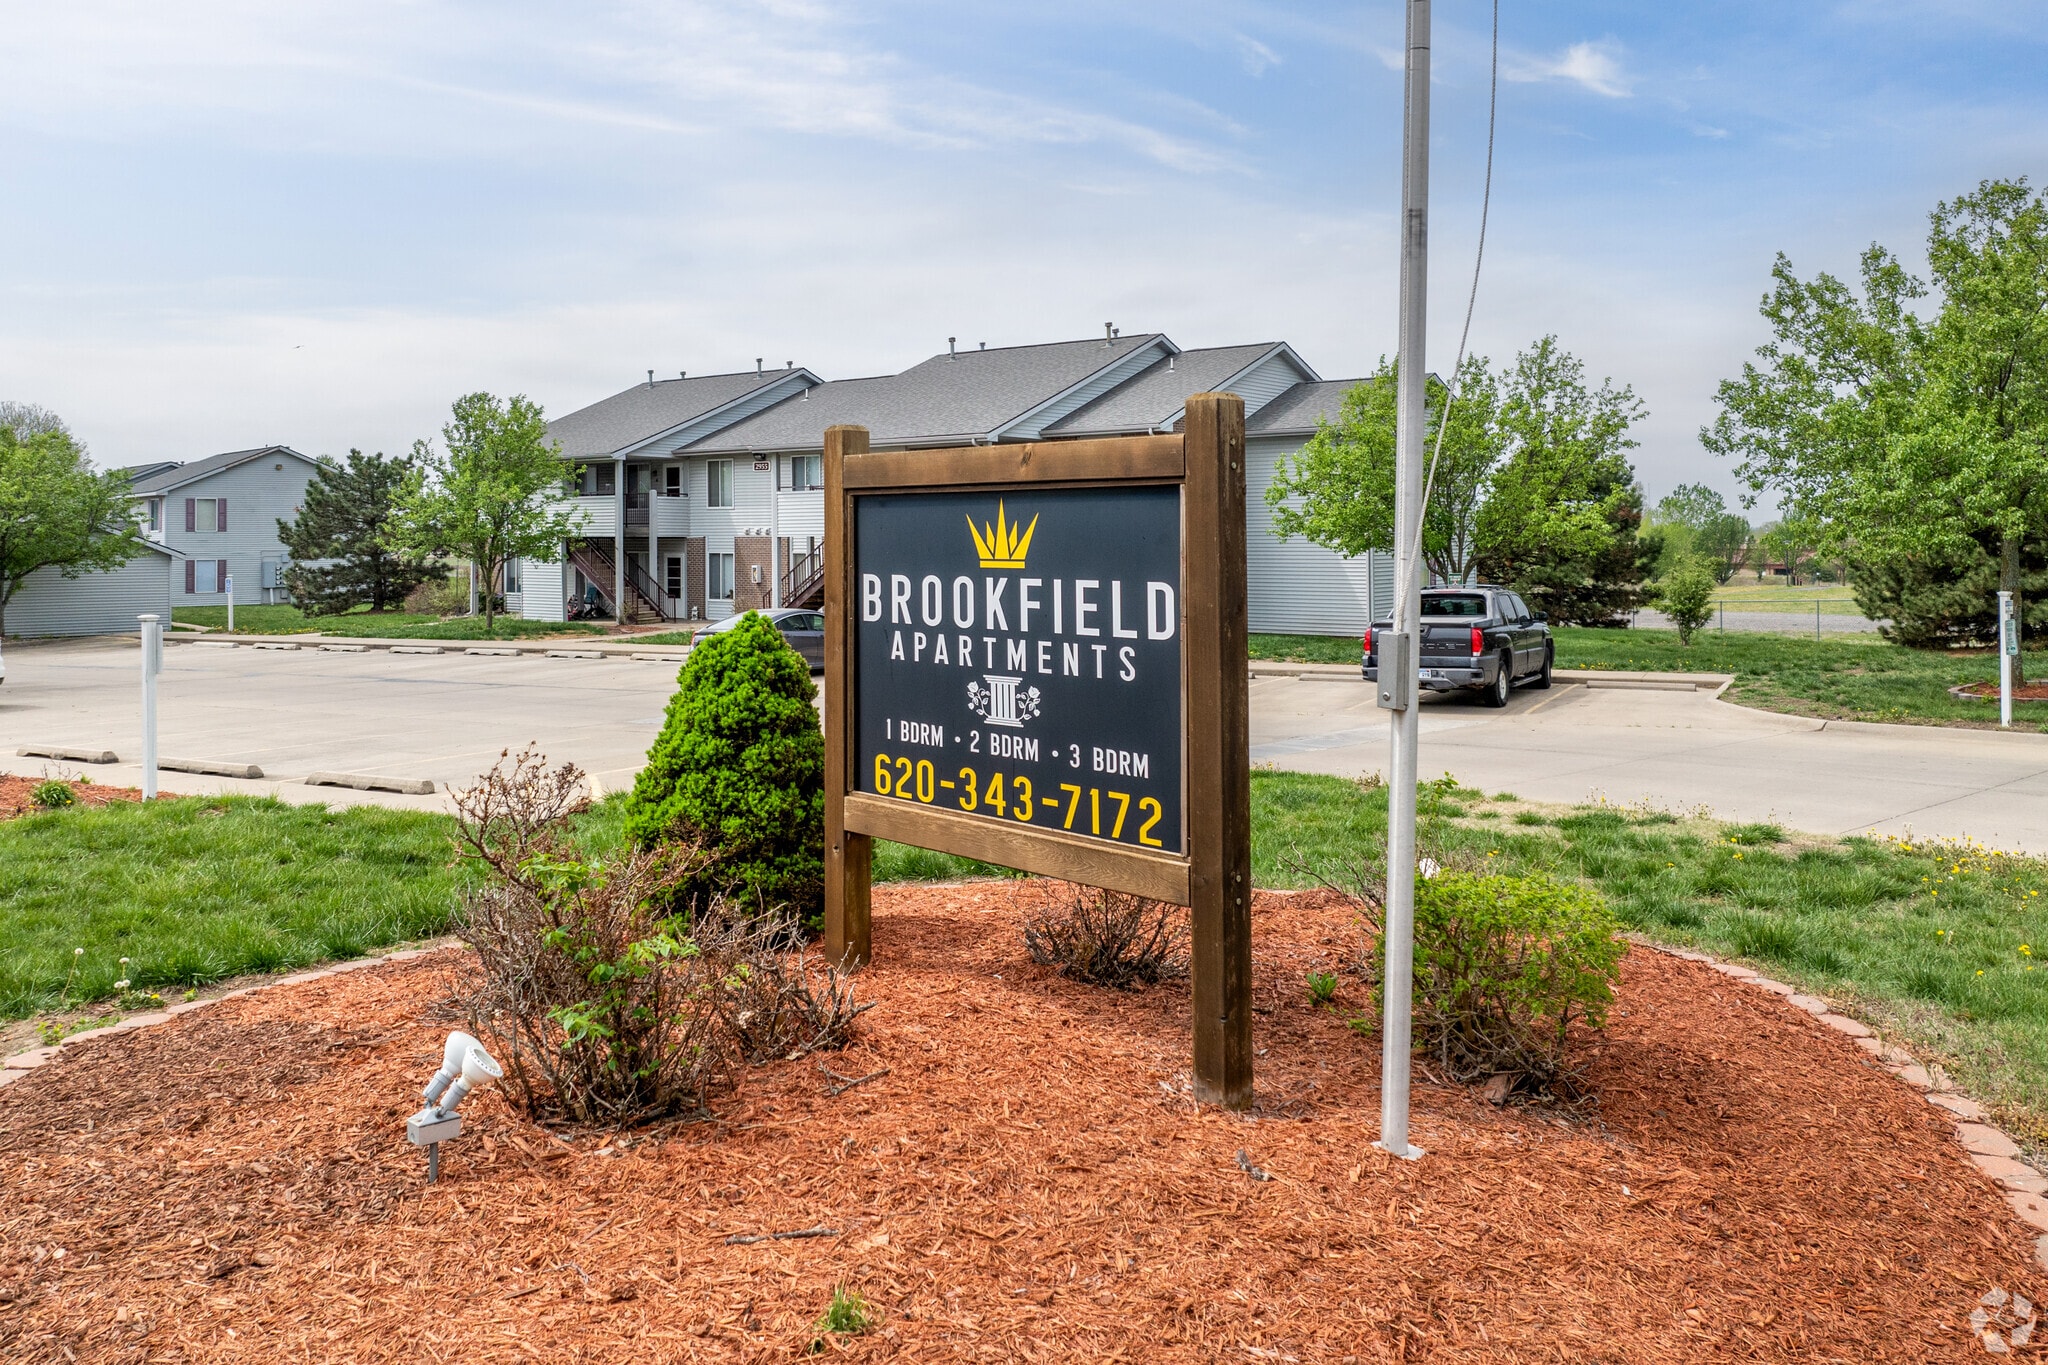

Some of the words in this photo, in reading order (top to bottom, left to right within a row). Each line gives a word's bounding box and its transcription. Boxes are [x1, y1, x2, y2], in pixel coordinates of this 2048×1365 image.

[863, 573, 1176, 641] BROOKFIELD
[890, 630, 1136, 682] APARTMENTS
[886, 717, 892, 740] 1
[900, 719, 944, 748] BDRM
[969, 729, 980, 754] 2
[990, 732, 1039, 763] BDRM
[1069, 743, 1081, 769] 3
[1092, 746, 1149, 779] BDRM
[875, 753, 1163, 847] 620-343-7172
